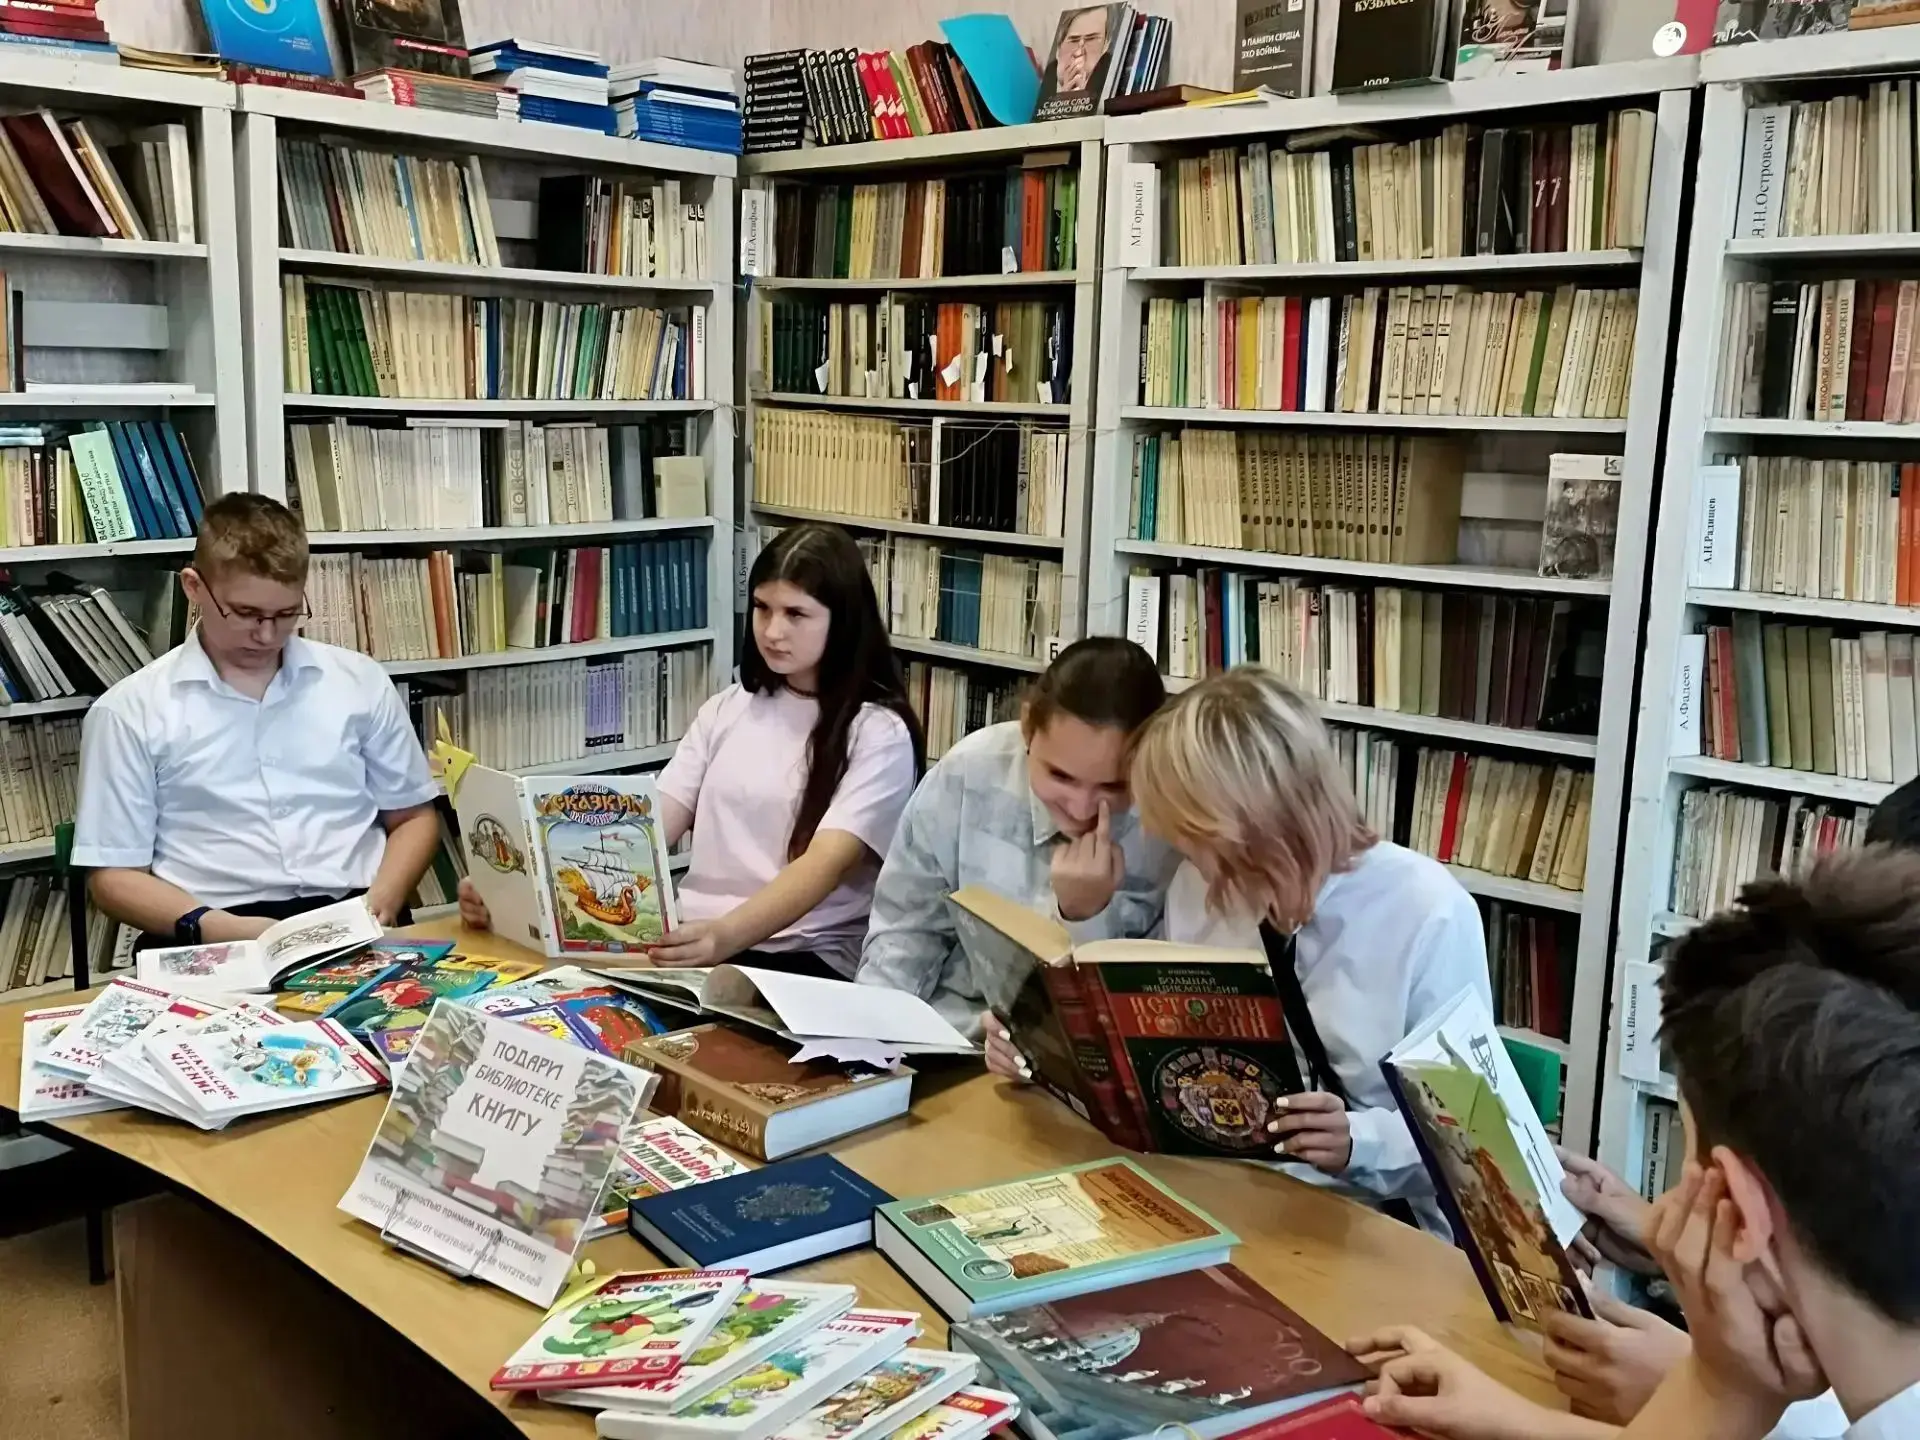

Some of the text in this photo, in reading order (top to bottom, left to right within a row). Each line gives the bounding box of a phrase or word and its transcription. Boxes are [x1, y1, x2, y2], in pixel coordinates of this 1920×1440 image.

[1070, 98, 1090, 106] СЛОВ
[1751, 114, 1776, 239] А.Н.Островский
[1130, 181, 1146, 248] М.Горький
[1819, 302, 1833, 411] НИКОЛАЙ ОСТРОВСКИЙ
[1703, 497, 1717, 566] А.Н.Радищев
[1678, 664, 1692, 731] А.Фадеев
[550, 794, 634, 813] СКАЗКИ
[1142, 985, 1238, 994] ЭНЦИКЛОПЕДИЯ
[1158, 977, 1216, 985] БОЛЬШАЯ
[1136, 1014, 1270, 1038] РОССИИ
[1626, 984, 1638, 1029] Шолохов
[170, 1052, 217, 1096] ЧТЕНИЕ
[177, 1042, 239, 1101] ВНЕКЛАССНОЕ
[492, 1040, 564, 1081] ПОДАРИ
[474, 1064, 563, 1110] БИБЛИОТЕКЕ
[466, 1092, 542, 1137] КНИГУ
[640, 1132, 722, 1180] ДИНОЗАВРЫ
[441, 1205, 474, 1229] примем
[406, 1215, 421, 1229] дар
[423, 1221, 432, 1232] от
[433, 1228, 475, 1253] читателей
[497, 1259, 543, 1288] читателей
